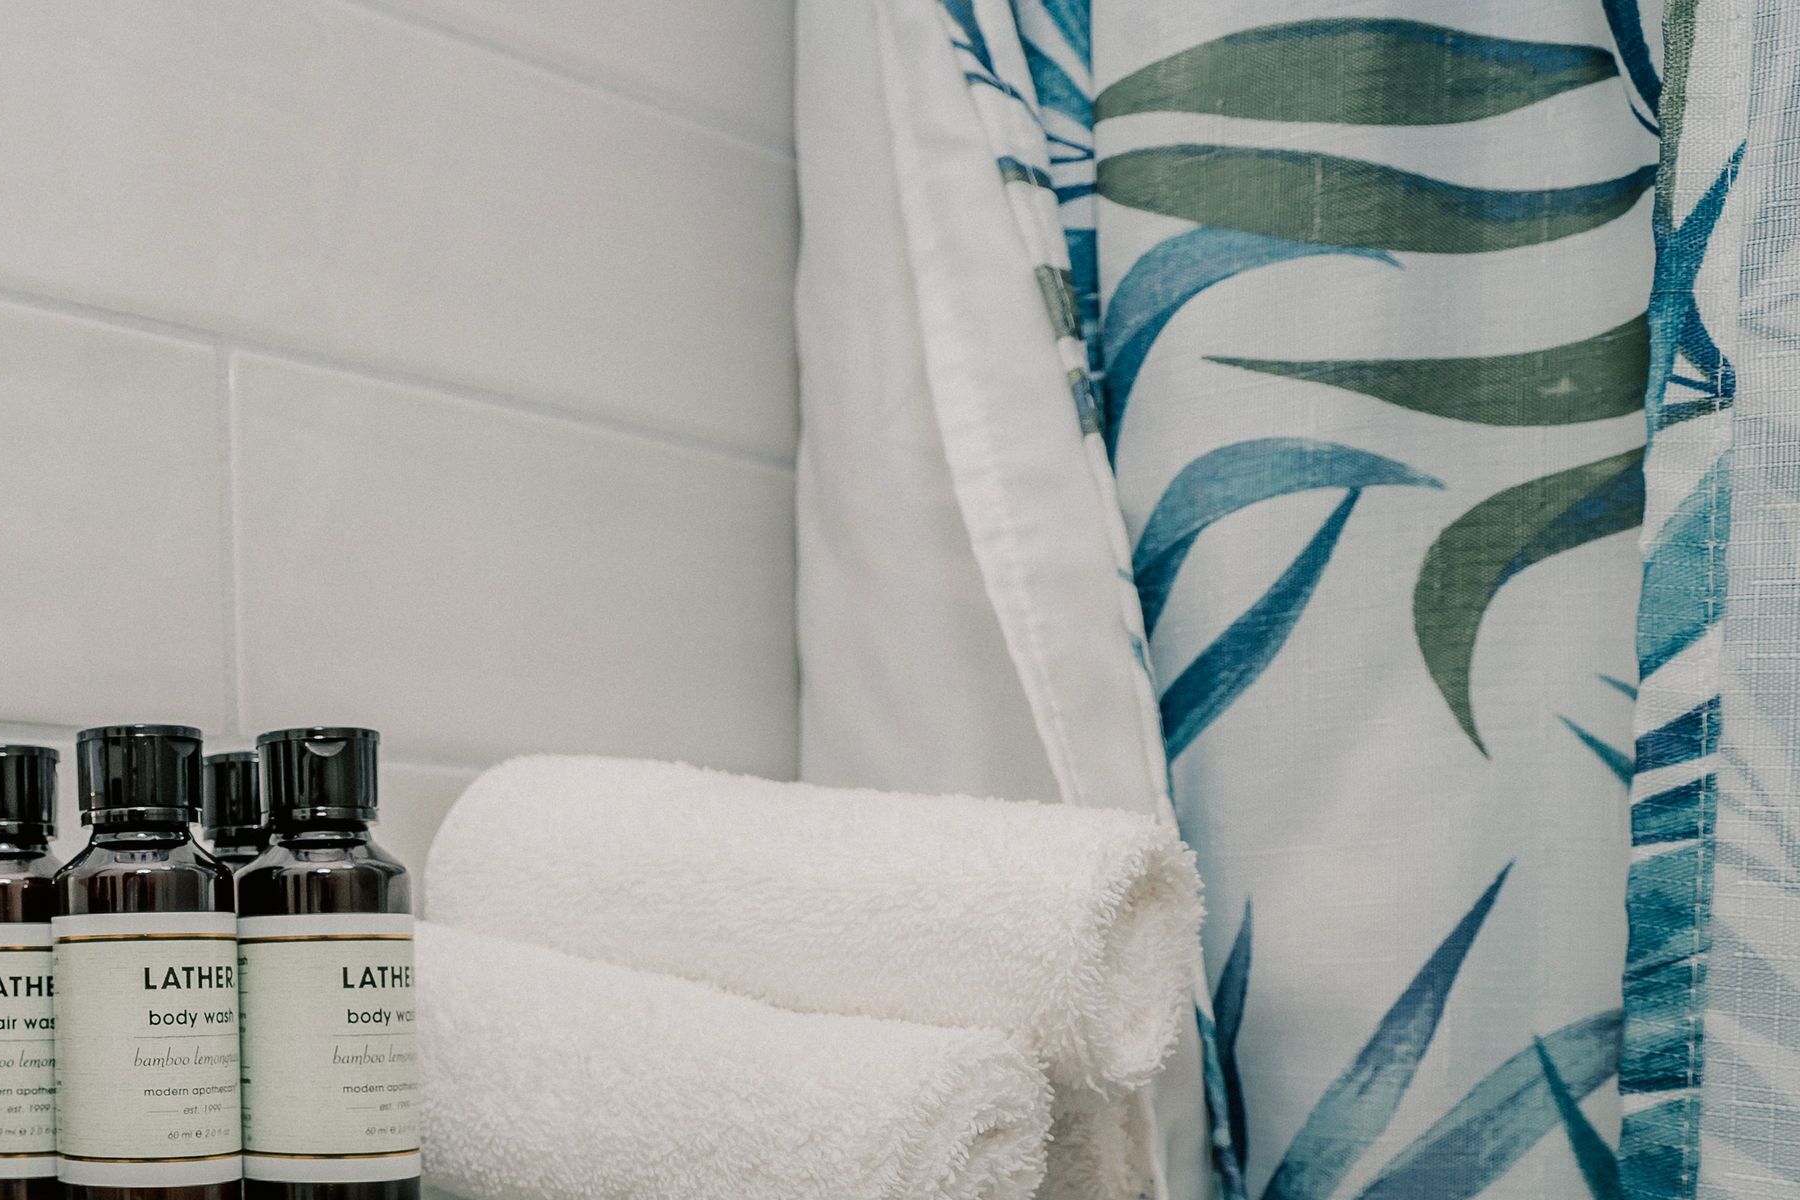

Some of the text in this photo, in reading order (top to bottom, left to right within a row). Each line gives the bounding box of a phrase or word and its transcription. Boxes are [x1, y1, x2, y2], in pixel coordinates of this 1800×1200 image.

[23, 1017, 56, 1030] was
[148, 1009, 198, 1029] body
[203, 1008, 234, 1024] wash
[347, 1008, 392, 1027] body
[133, 1047, 190, 1068] bamboo
[332, 1044, 386, 1065] bamboo
[143, 1087, 189, 1097] modern
[342, 1084, 385, 1094] modern
[167, 1130, 180, 1140] 60
[181, 1130, 193, 1139] ml
